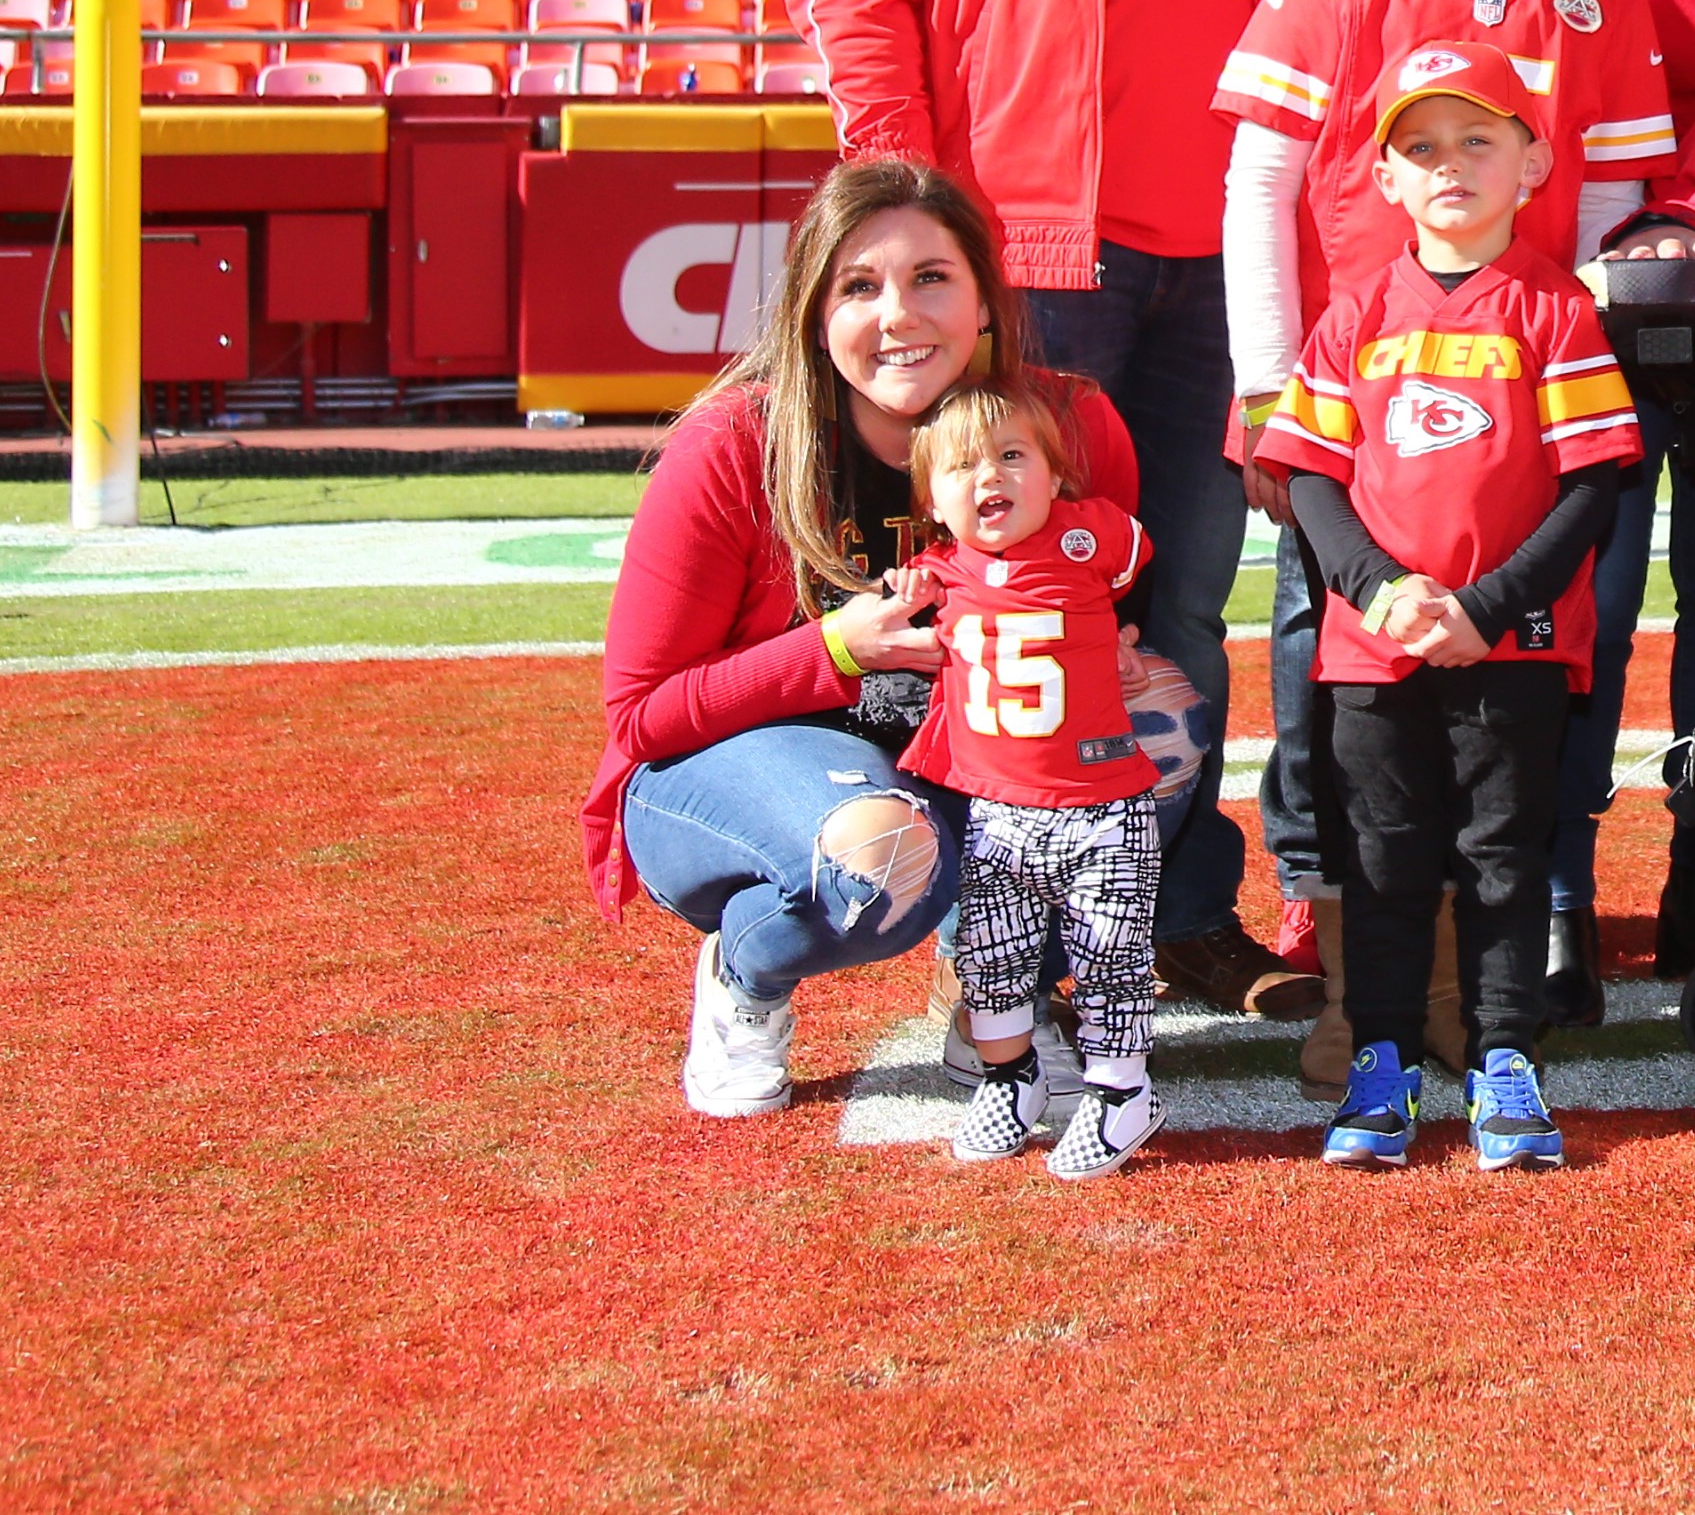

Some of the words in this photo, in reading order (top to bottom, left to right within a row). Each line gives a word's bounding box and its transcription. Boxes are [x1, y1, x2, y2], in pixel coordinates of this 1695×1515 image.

[1356, 330, 1523, 381] CHIEFS
[1410, 398, 1465, 437] KC
[1530, 621, 1552, 635] XS
[952, 609, 1066, 739] 15
